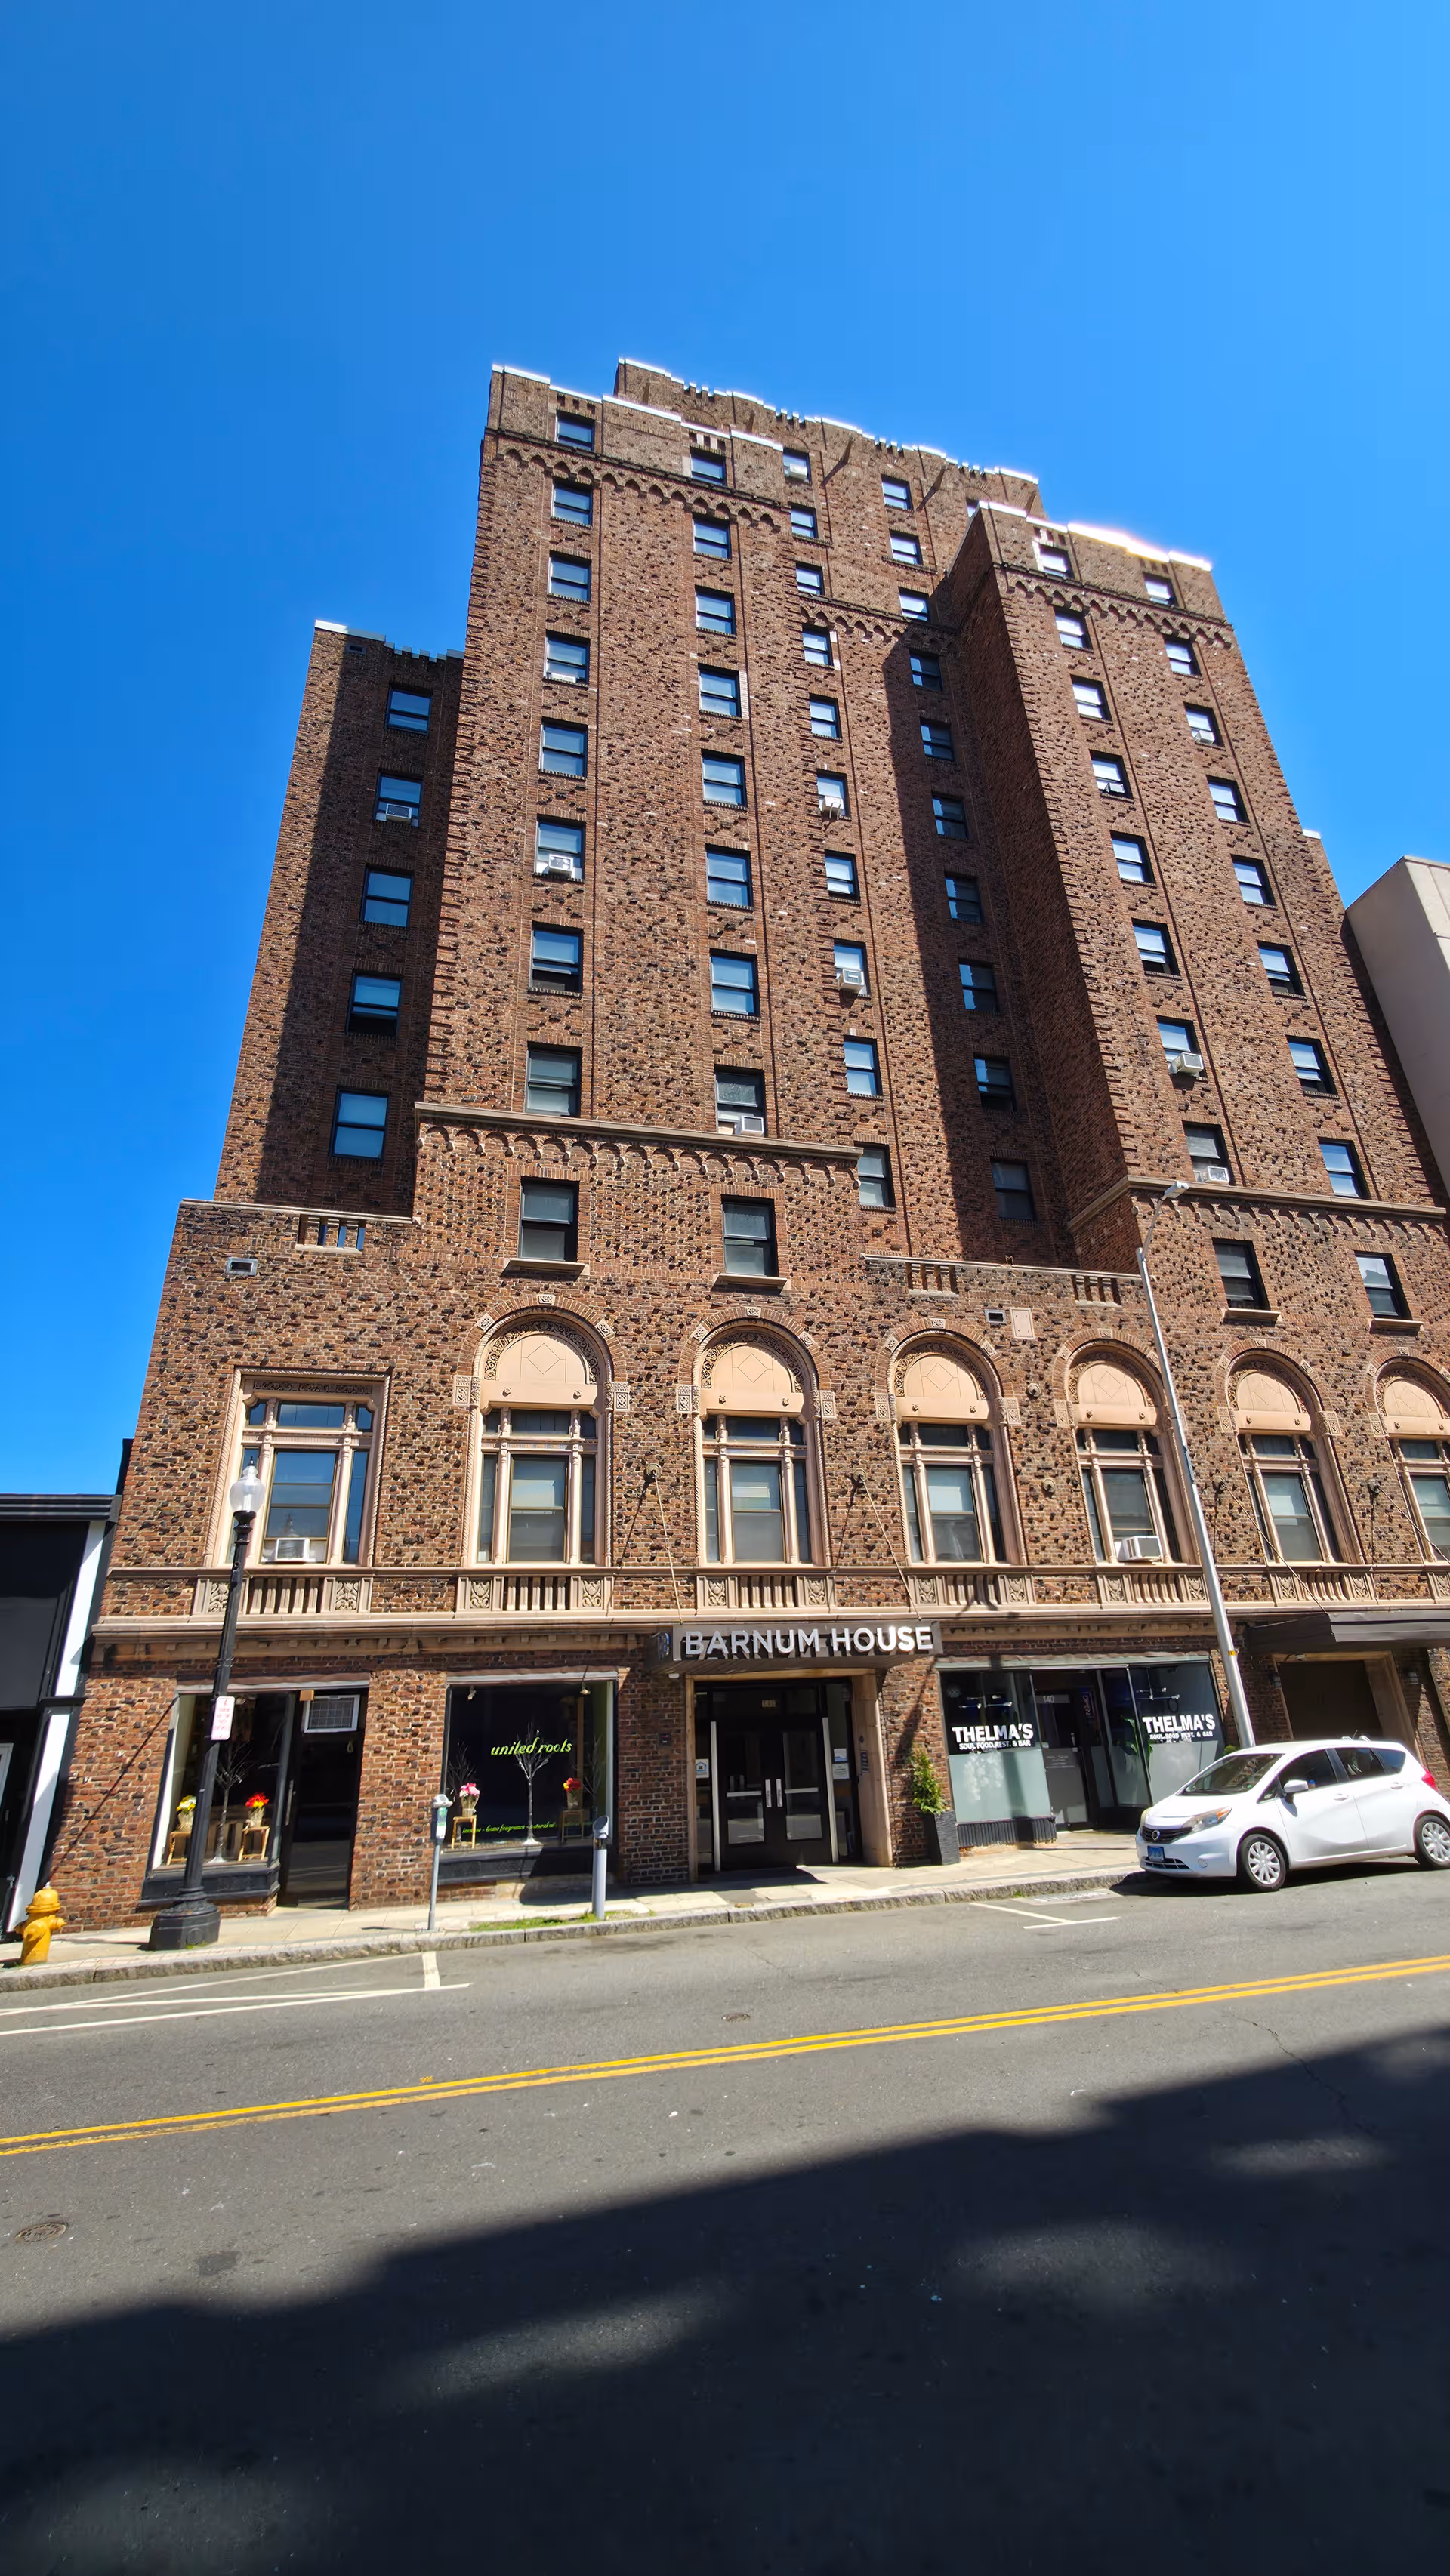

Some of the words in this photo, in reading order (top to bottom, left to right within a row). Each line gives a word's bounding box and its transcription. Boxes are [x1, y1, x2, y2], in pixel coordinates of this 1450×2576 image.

[685, 1628, 820, 1655] BARNUM
[831, 1625, 933, 1652] HOUSE
[1043, 1695, 1055, 1703] 140
[1142, 1713, 1216, 1733] THELMA'S
[952, 1723, 1034, 1743] THELMA'S
[490, 1736, 540, 1755] united
[537, 1738, 572, 1753] roots
[959, 1742, 976, 1750] SOUL
